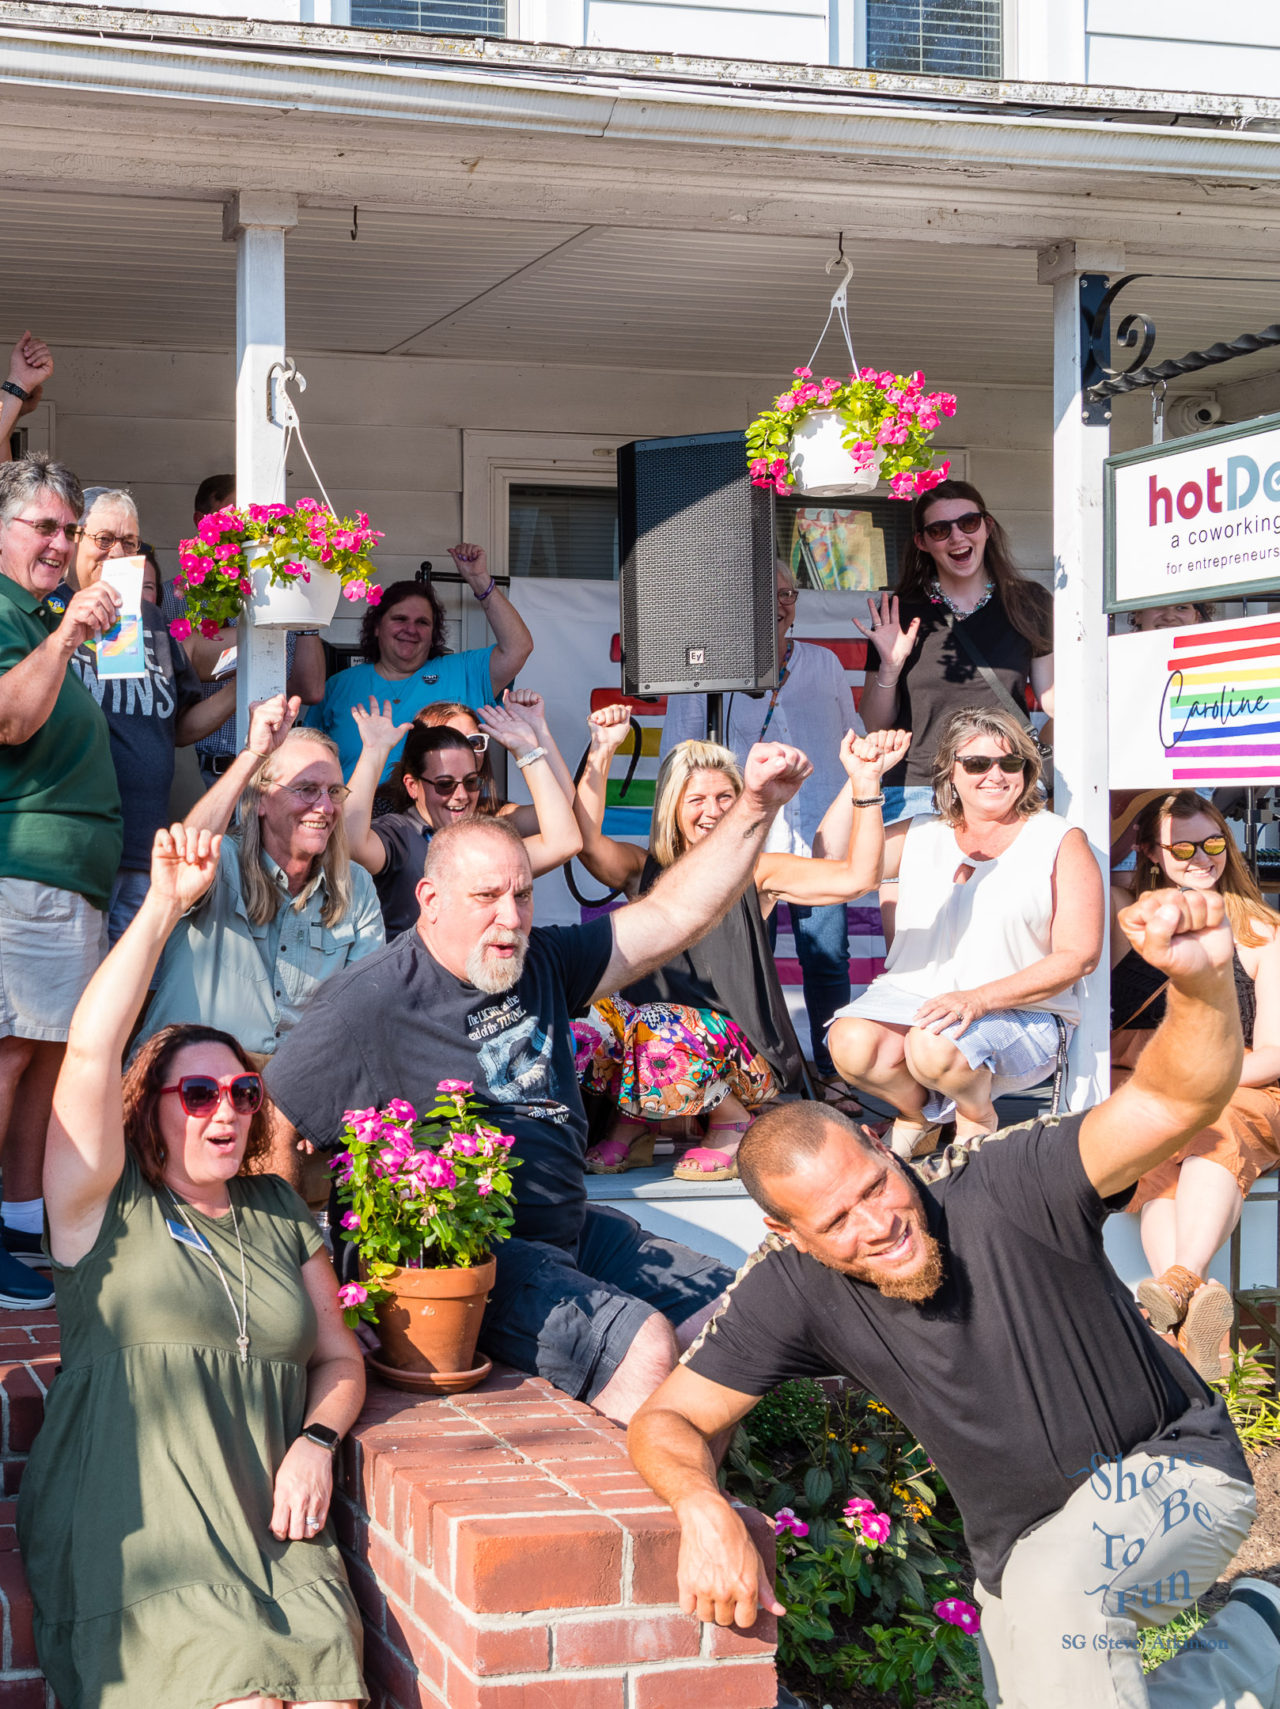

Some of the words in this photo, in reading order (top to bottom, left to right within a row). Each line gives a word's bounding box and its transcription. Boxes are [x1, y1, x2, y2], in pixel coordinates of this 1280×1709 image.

[1171, 535, 1180, 549] a
[1188, 515, 1280, 545] coworking
[1166, 562, 1183, 575] for
[1187, 546, 1280, 572] entrepreneurs
[1158, 670, 1270, 750] Caroline
[468, 1027, 482, 1041] end
[481, 1025, 489, 1037] of
